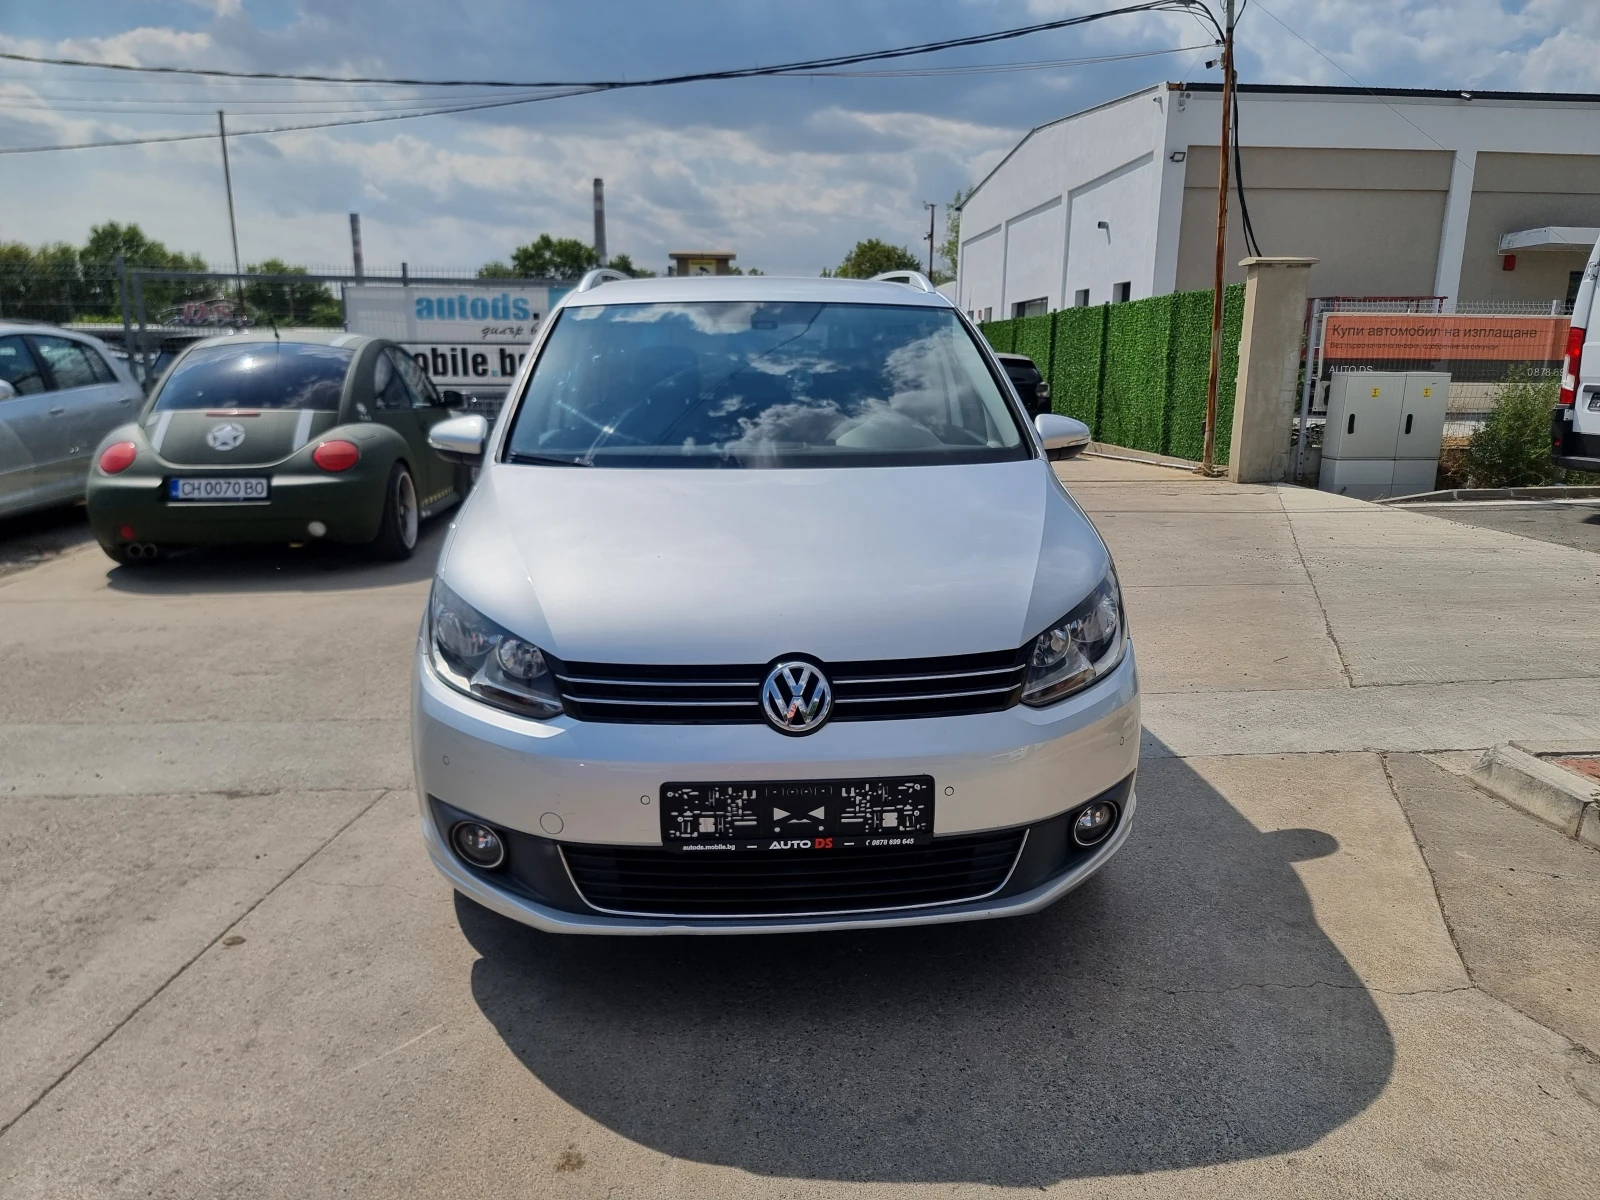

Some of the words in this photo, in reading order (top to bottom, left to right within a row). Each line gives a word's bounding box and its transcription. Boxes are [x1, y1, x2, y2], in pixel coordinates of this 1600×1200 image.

[482, 326, 524, 340] дилър
[1332, 324, 1364, 338] Купи
[1368, 325, 1440, 337] автомобил
[1444, 328, 1460, 337] на
[1463, 328, 1537, 339] изплащане
[1527, 367, 1551, 377] 0878
[182, 482, 202, 496] CH
[204, 481, 241, 496] 0070
[682, 843, 736, 851] autods.mobile.bg
[768, 840, 811, 850] AUTO
[814, 838, 833, 849] DS
